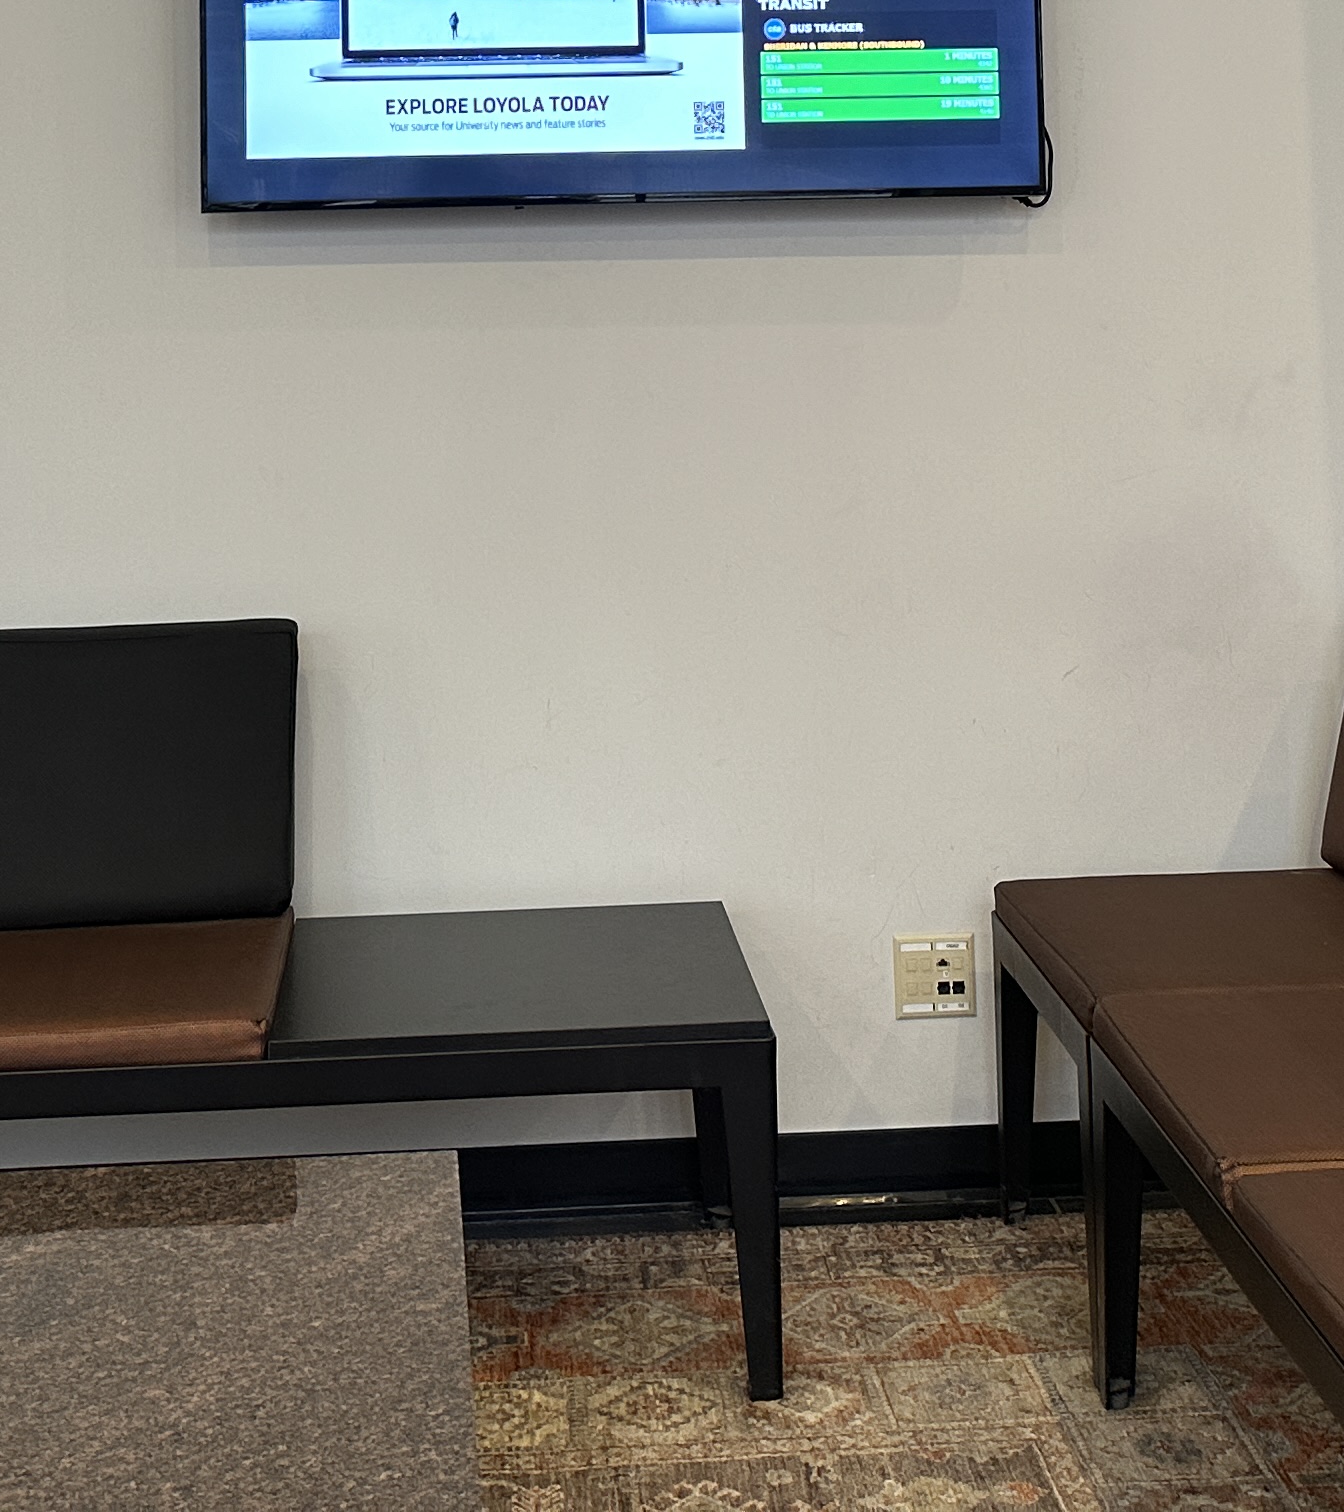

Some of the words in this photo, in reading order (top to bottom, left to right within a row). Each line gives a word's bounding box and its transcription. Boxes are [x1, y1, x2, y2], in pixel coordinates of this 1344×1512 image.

[789, 23, 812, 34] BUS
[814, 22, 863, 34] TRACKER
[386, 98, 468, 115] EXPLORE
[473, 97, 544, 113] LOYOLA
[549, 95, 609, 112] TODAY
[389, 122, 409, 132] Your
[411, 121, 439, 131] source
[441, 121, 454, 130] for
[456, 120, 498, 131] University
[500, 121, 523, 130] news
[525, 120, 542, 129] and
[544, 119, 575, 129] feature
[577, 118, 606, 128] stories
